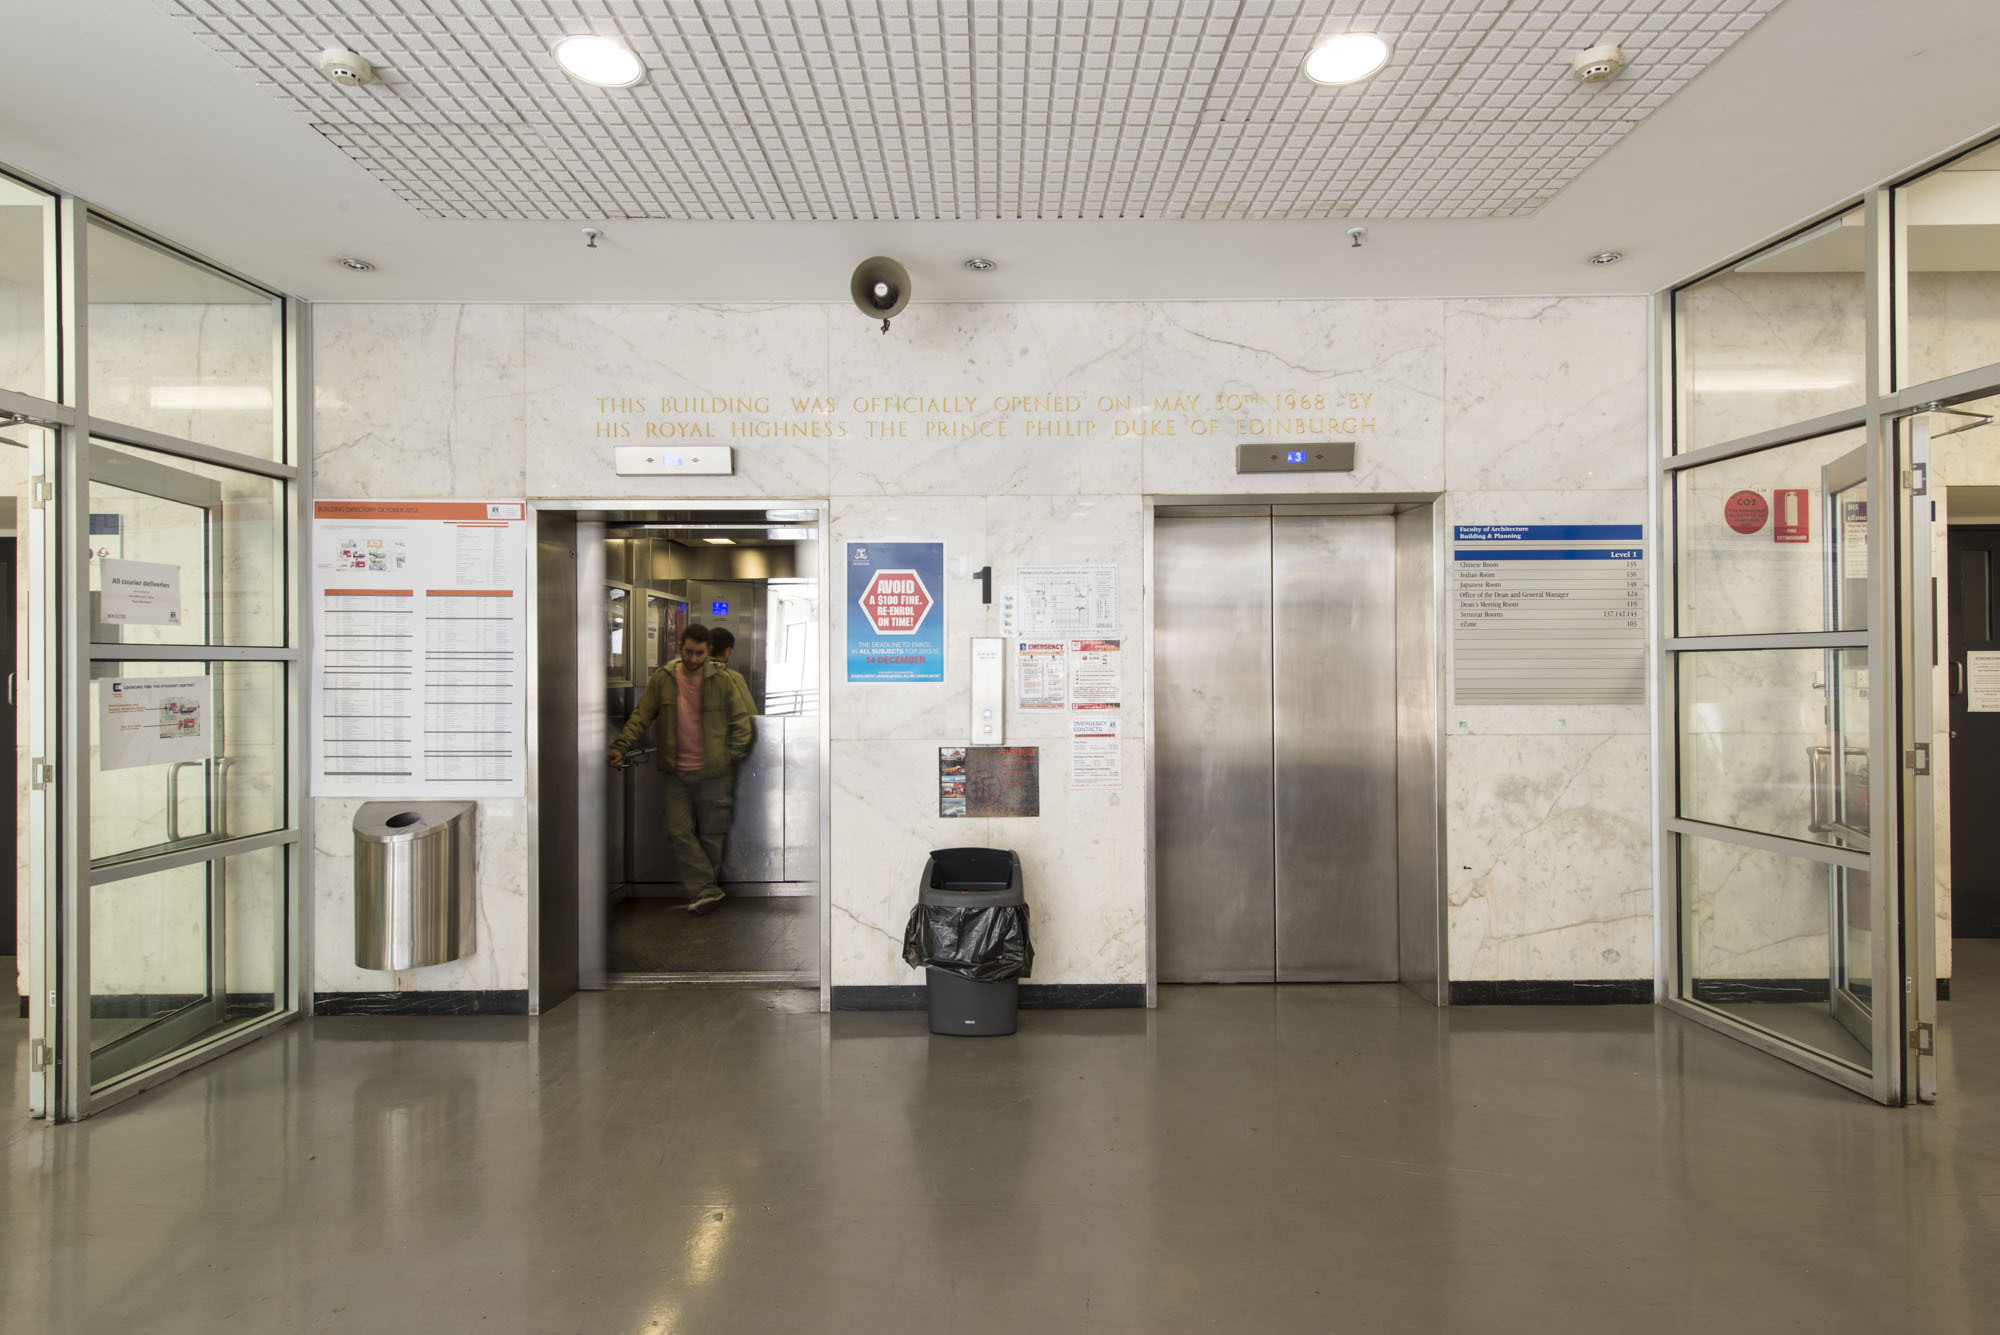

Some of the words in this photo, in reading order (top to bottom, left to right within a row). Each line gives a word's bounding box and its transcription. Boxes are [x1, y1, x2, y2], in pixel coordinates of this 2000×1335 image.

[596, 396, 646, 414] THIS
[661, 396, 770, 414] BUILDING
[791, 396, 836, 413] WAS
[852, 396, 977, 414] OFFICIALLY
[994, 396, 1081, 412] OPENED
[1098, 395, 1131, 412] ON
[1153, 394, 1199, 411] MAY
[1276, 393, 1326, 411] 1968
[1349, 392, 1373, 409] BY
[596, 421, 631, 438] HIS
[646, 421, 716, 438] ROYAL
[731, 421, 848, 438] HIGHNESS
[866, 420, 909, 438] THE
[926, 420, 1008, 437] PRINCE
[1026, 419, 1096, 437] PHILIP
[1115, 419, 1177, 436] DUKE
[1191, 418, 1219, 435] OF
[1236, 417, 1376, 435] EDINBURGH
[1294, 452, 1302, 463] 3
[143, 580, 170, 588] deliveries
[877, 580, 915, 594] AVOID
[1545, 591, 1569, 599] Manager
[869, 596, 875, 605] A
[878, 596, 898, 605] $100
[901, 596, 922, 605] FINE.
[877, 606, 915, 616] RE-ENROL
[878, 617, 890, 626] ON
[891, 617, 913, 626] TIME!
[866, 656, 875, 664] 14
[877, 656, 925, 664] DECEMBER
